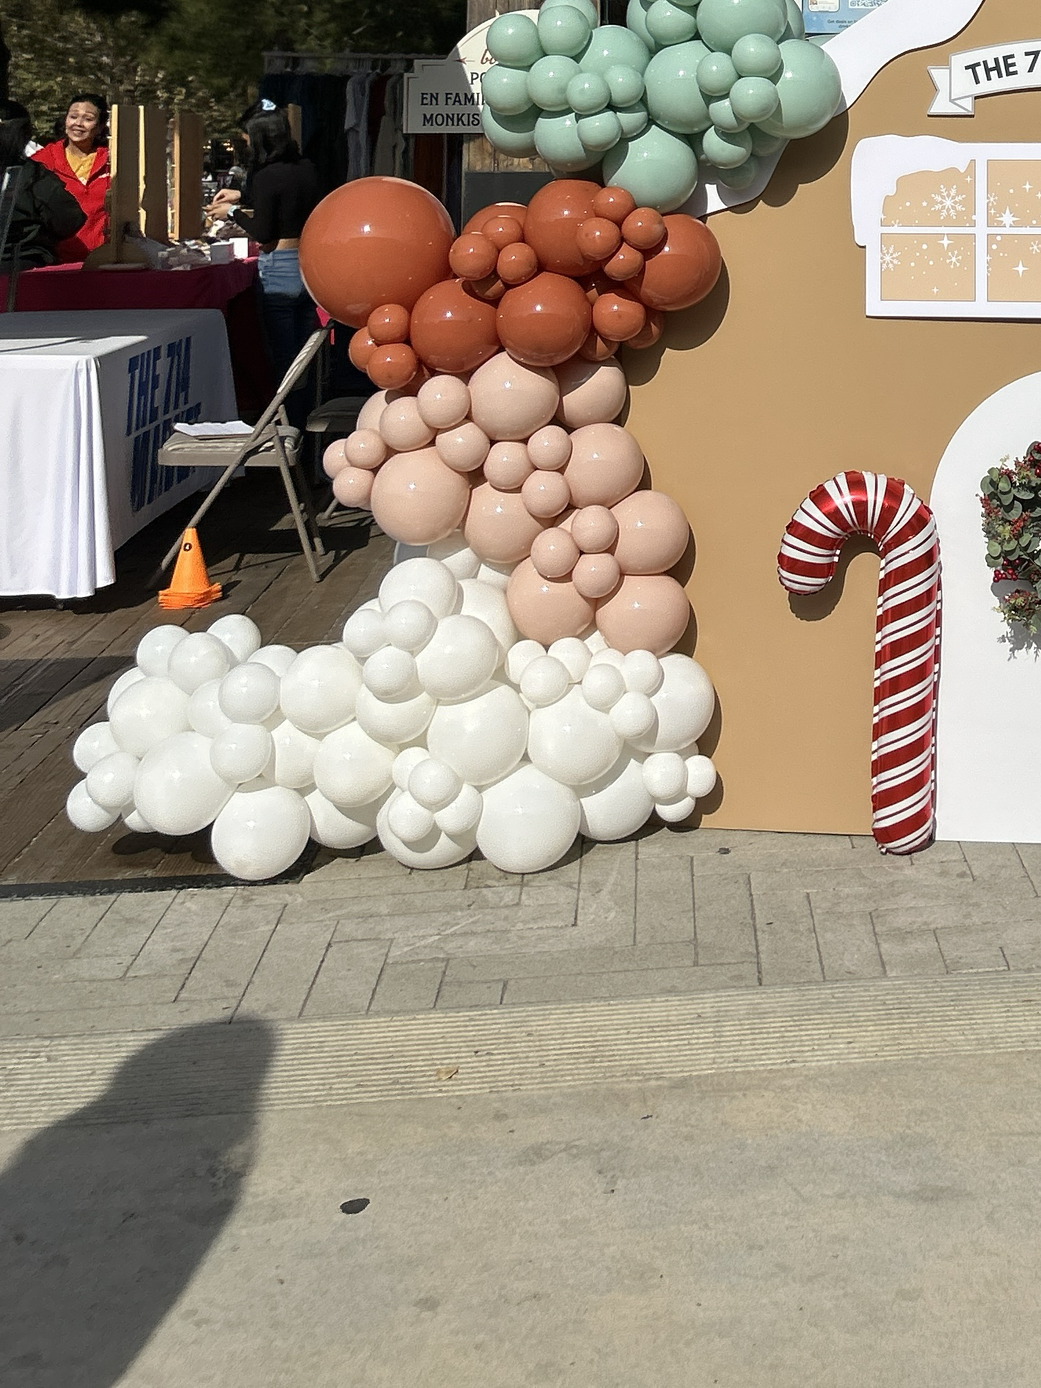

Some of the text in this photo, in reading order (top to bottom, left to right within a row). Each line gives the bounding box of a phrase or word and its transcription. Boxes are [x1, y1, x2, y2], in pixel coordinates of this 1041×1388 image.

[964, 53, 1018, 85] THE
[420, 92, 439, 106] EN
[125, 336, 192, 437] THE 714
